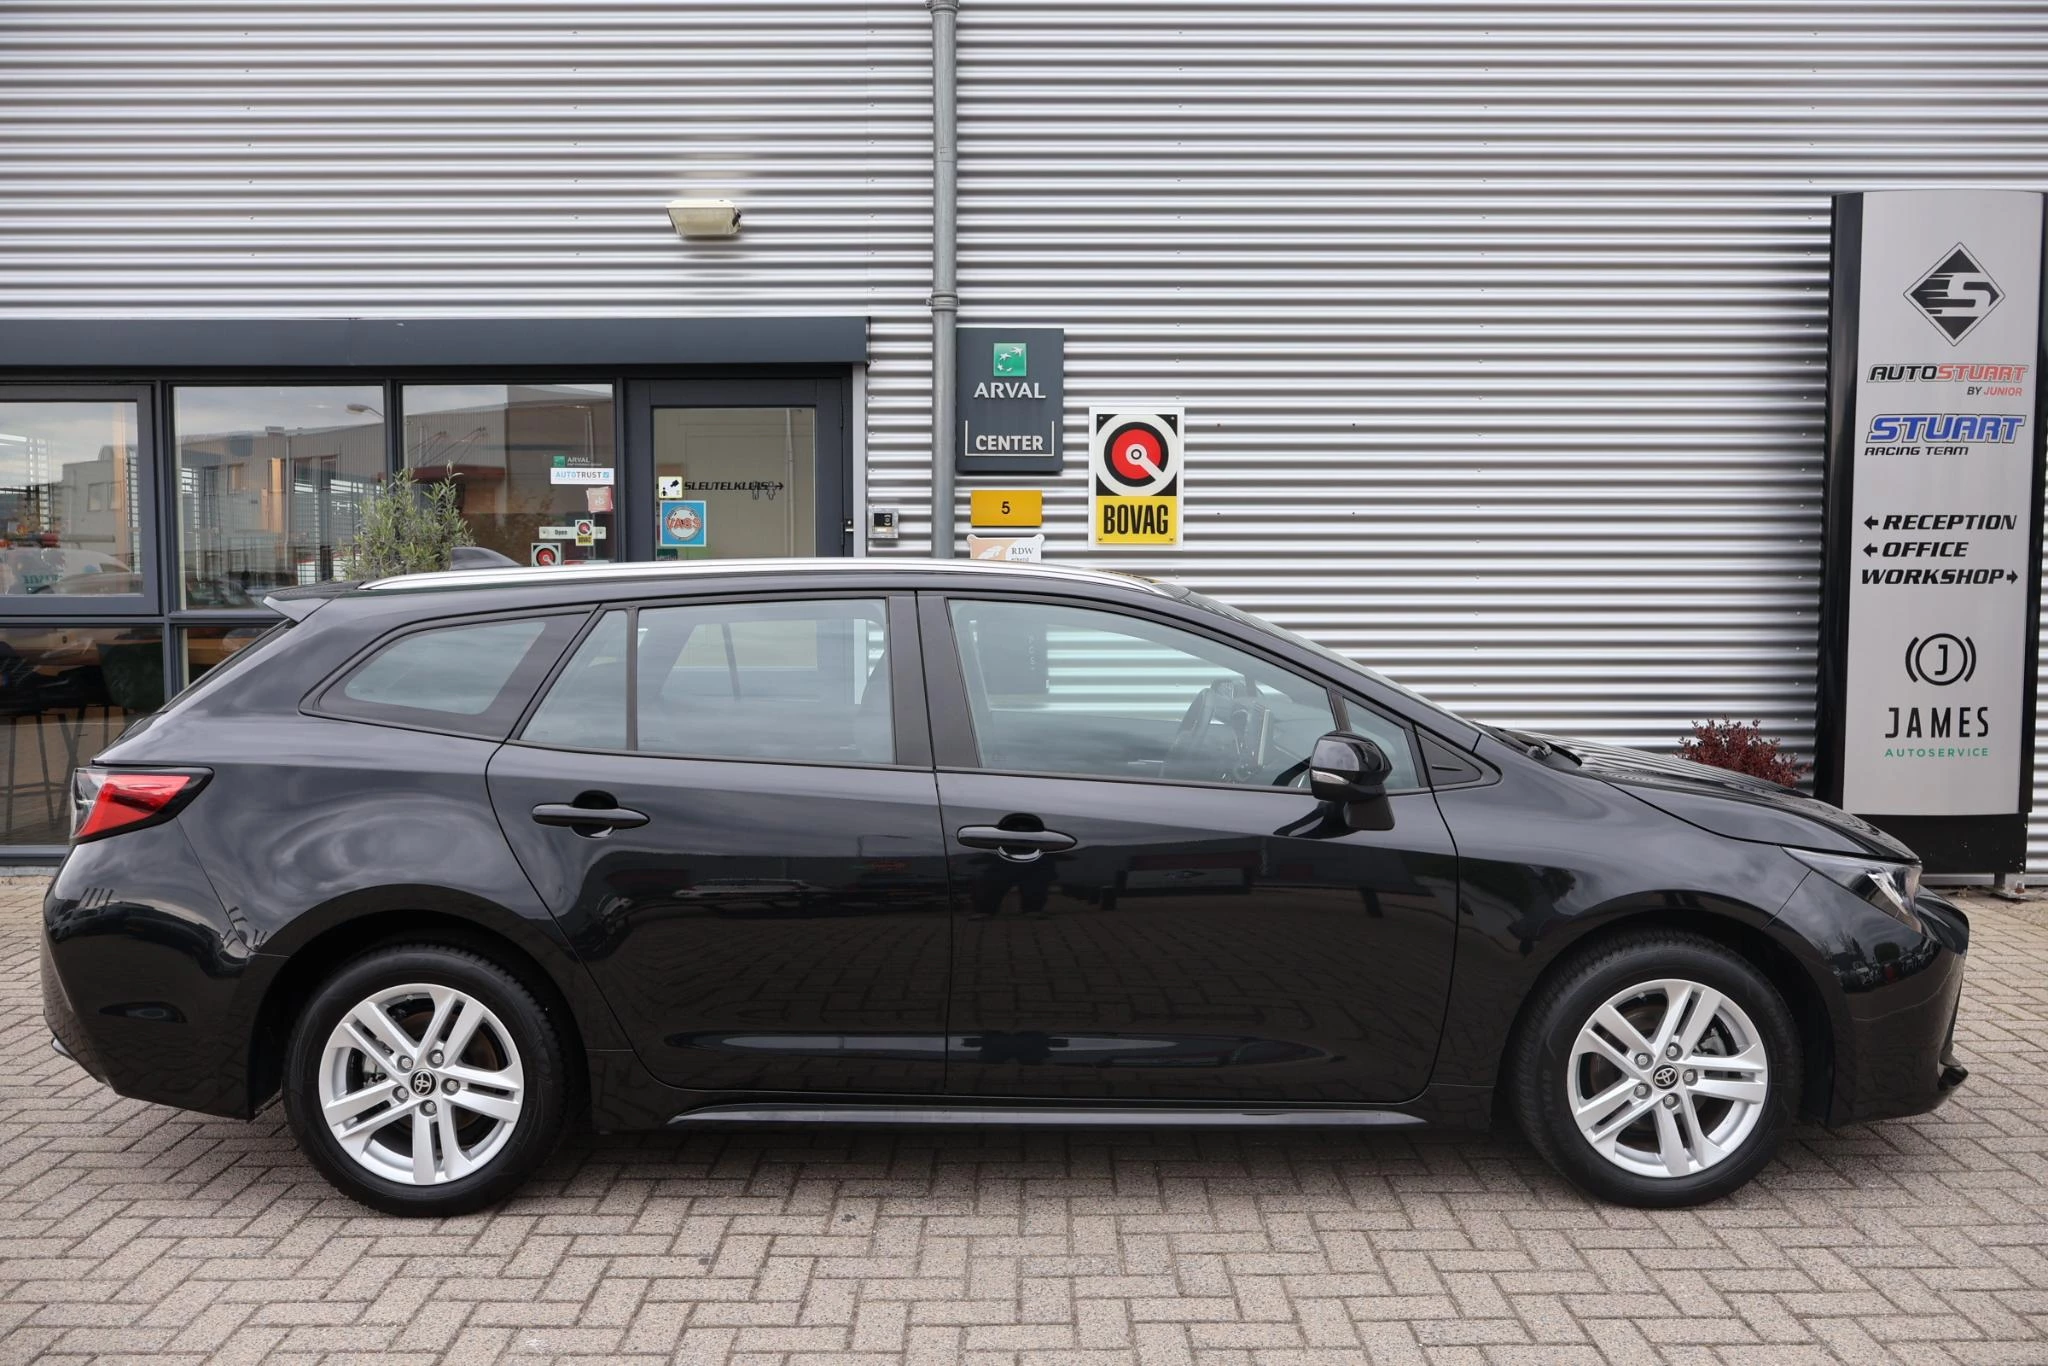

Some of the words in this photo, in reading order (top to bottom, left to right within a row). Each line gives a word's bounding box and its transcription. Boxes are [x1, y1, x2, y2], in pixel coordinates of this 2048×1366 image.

[1868, 364, 2028, 382] AUTOSTUART
[974, 382, 1046, 398] ARVAL
[1966, 387, 1982, 395] BY
[1984, 387, 2022, 396] JUNIOR
[1868, 415, 2025, 442] STUART
[975, 435, 1044, 450] CENTER
[1864, 446, 1920, 456] RACING
[1925, 446, 1969, 456] TEAM
[1001, 501, 1011, 514] 5
[1103, 504, 1169, 535] BOVAG
[1882, 515, 2017, 530] RECEPTION
[1011, 547, 1034, 555] RDW
[1882, 542, 1969, 557] OFFICE
[1861, 569, 2005, 584] WORKSHOP
[1885, 706, 1989, 738] JAMES
[1884, 748, 1989, 757] AUTOSERVICE
